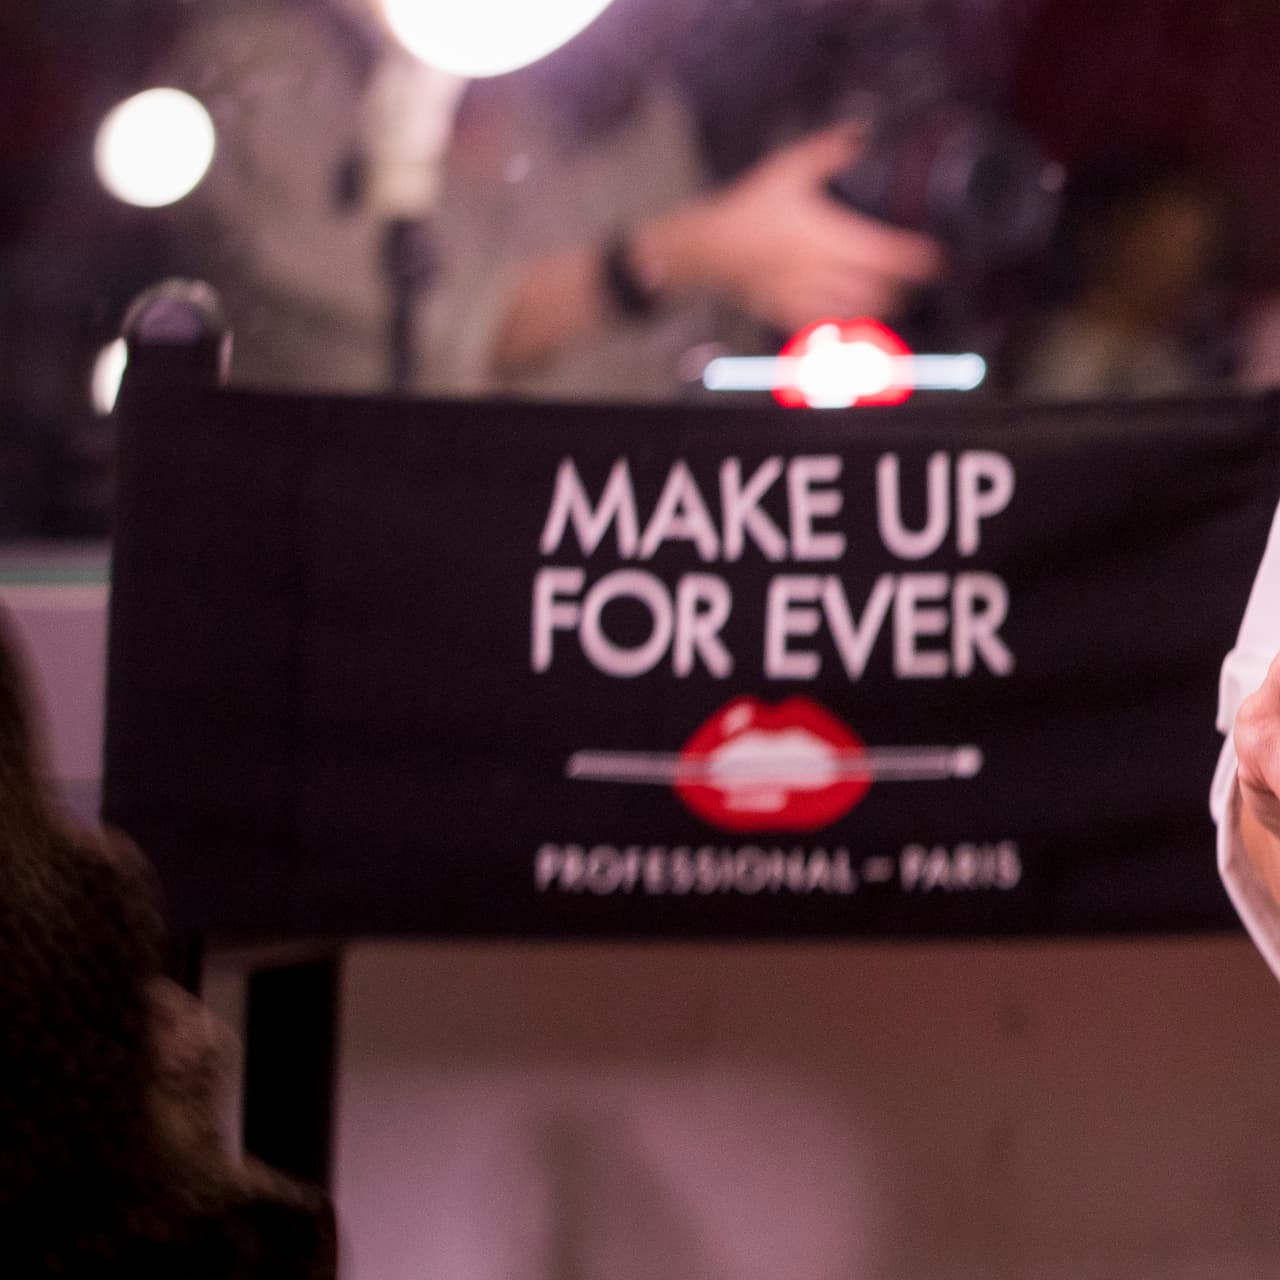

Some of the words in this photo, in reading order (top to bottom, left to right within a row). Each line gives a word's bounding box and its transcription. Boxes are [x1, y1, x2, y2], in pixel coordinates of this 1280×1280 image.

[539, 454, 846, 563] MAKE
[876, 451, 1016, 560] UP
[531, 566, 734, 678] FOR
[763, 571, 1015, 682] EVER
[534, 841, 858, 896] PROFESSIONAL
[900, 838, 1023, 892] PARIS
